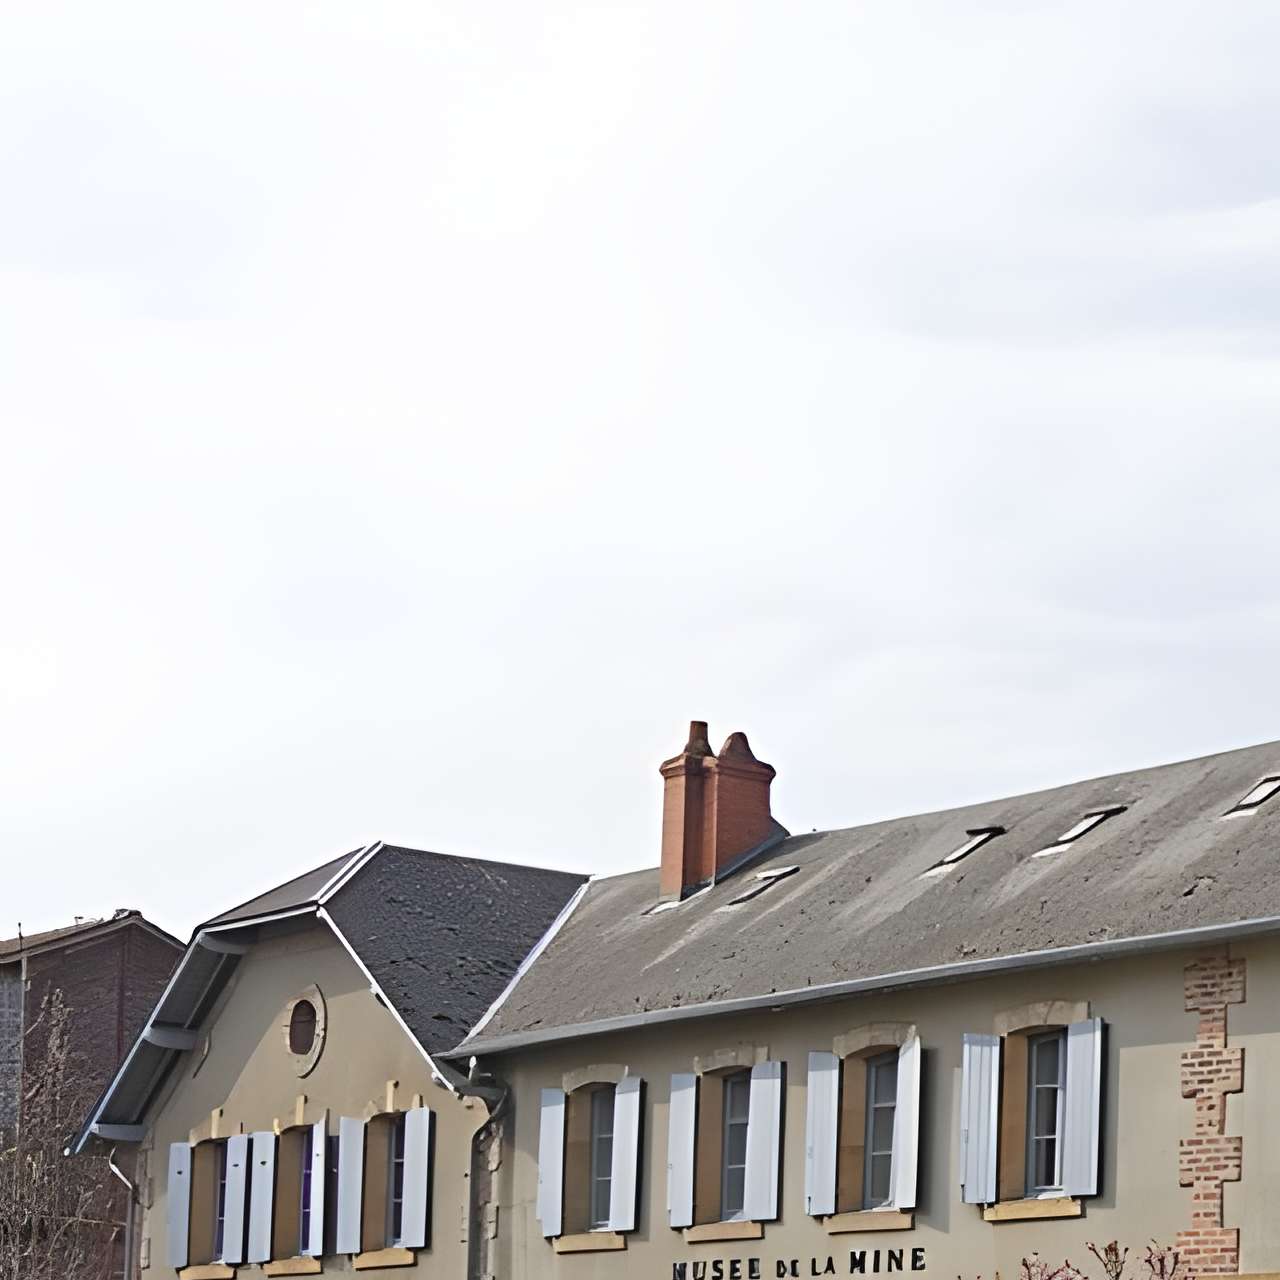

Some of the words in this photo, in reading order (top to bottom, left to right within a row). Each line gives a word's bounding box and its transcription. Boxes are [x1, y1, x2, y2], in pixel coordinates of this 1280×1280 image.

[776, 1259, 800, 1278] DE
[811, 1256, 836, 1276] LA
[849, 1247, 926, 1274] MINE
